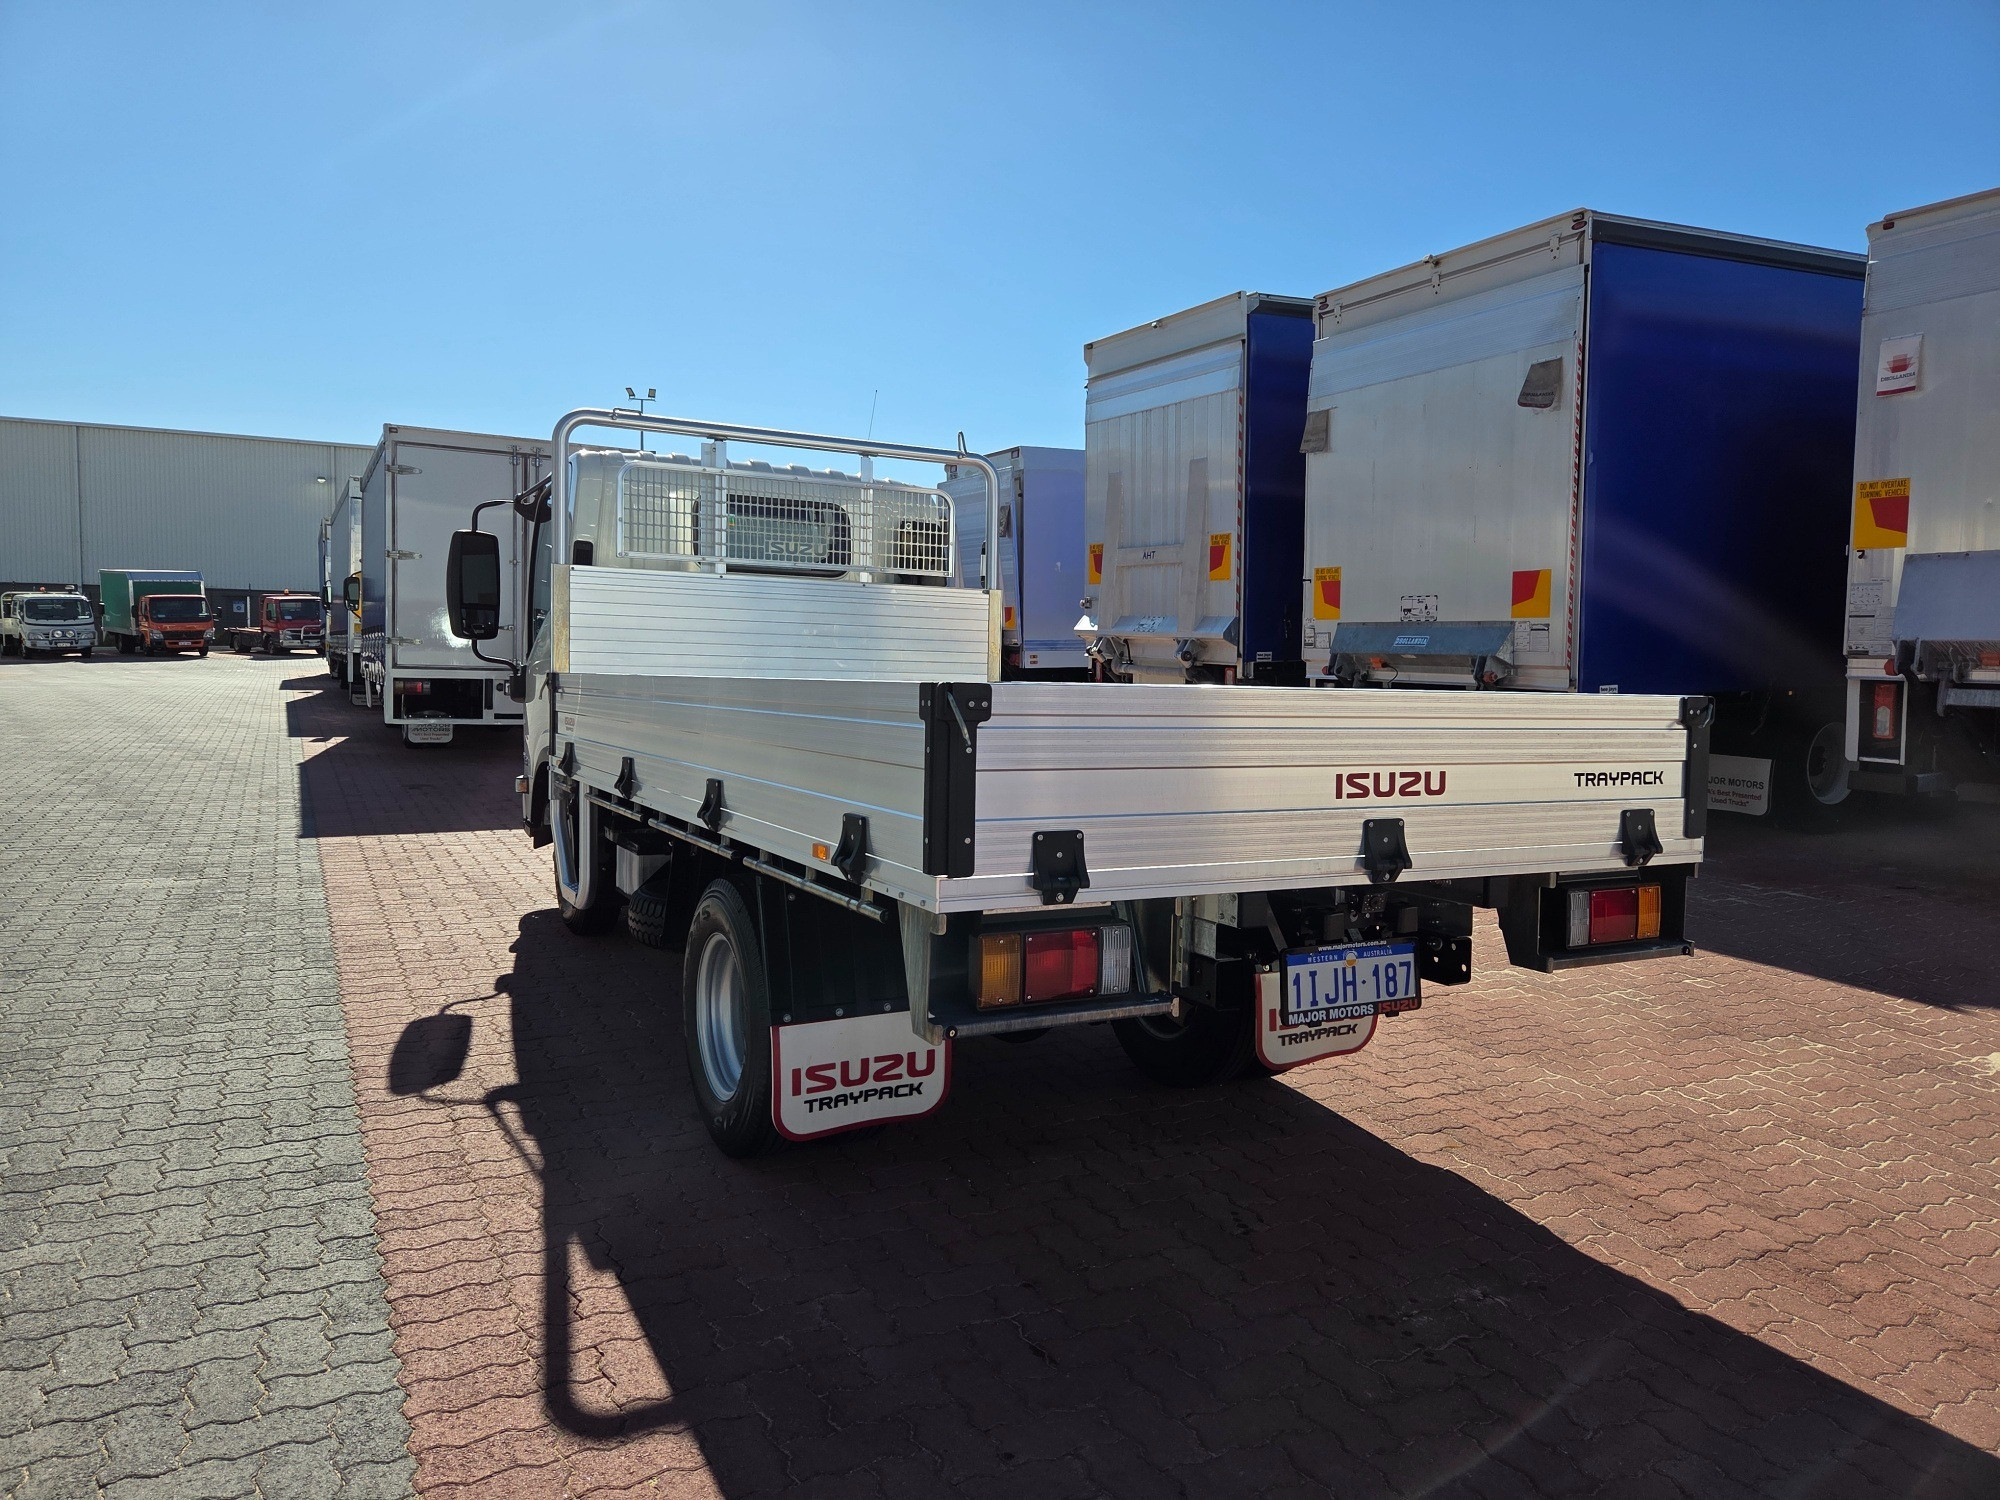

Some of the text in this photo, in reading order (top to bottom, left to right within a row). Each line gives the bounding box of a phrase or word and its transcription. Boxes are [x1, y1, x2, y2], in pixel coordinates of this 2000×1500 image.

[1881, 480, 1907, 488] OVERTAKE
[765, 541, 827, 556] ISUZU
[1142, 551, 1156, 559] AHT
[1335, 770, 1447, 799] ISUZU
[1574, 770, 1664, 787] TRAYPACK
[1708, 776, 1765, 790] JOR MOTORS
[1318, 940, 1387, 952] www.majormotors.com.au
[1307, 949, 1393, 963] WESTERN AUSTRALIA
[1379, 998, 1418, 1013] ISUZU
[1288, 1010, 1327, 1025] MAJOR
[1329, 1004, 1374, 1019] MOTORS
[1278, 1024, 1358, 1046] TRAYPACK
[791, 1049, 935, 1097] ISUZU
[804, 1082, 923, 1113] TRAYPACK
